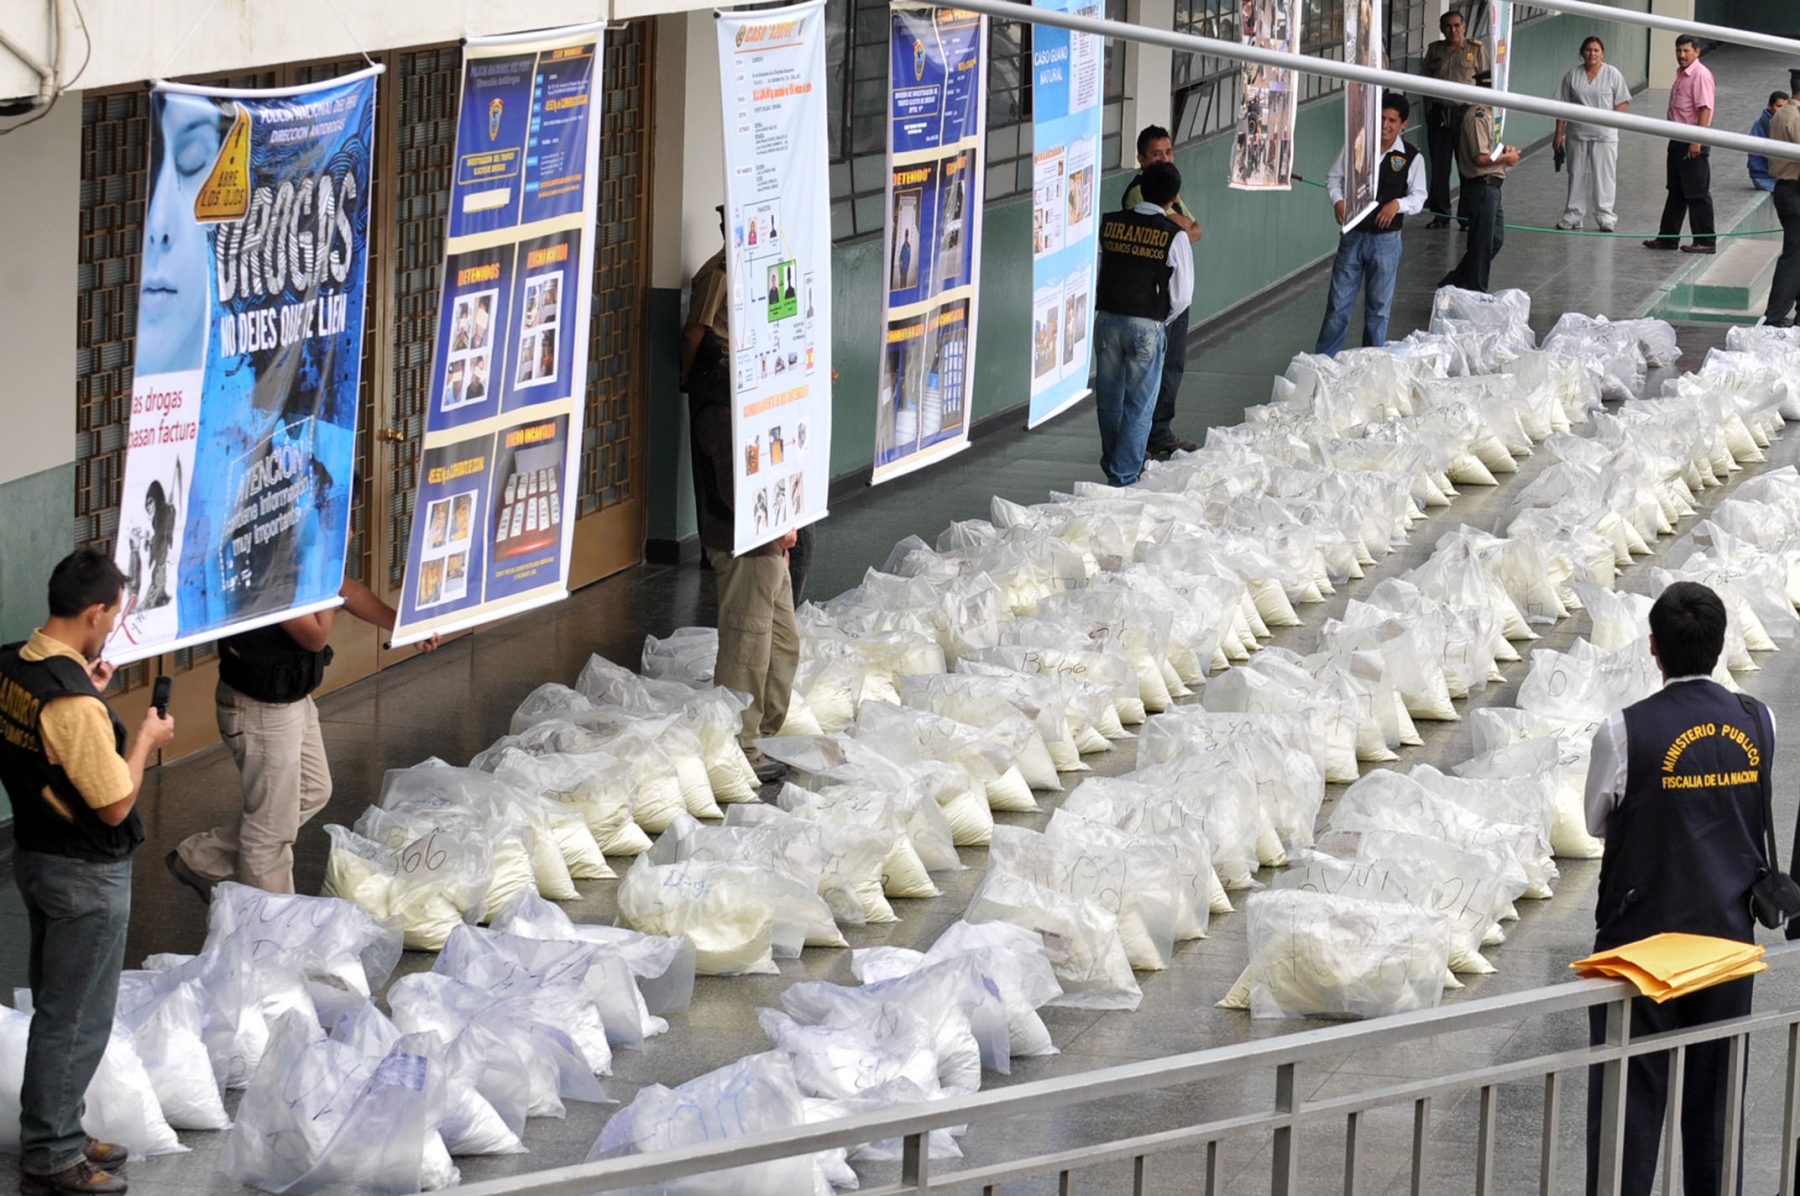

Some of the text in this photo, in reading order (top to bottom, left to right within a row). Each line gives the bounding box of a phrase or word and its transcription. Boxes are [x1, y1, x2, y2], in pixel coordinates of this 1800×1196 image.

[1034, 52, 1050, 66] CASO
[1039, 67, 1063, 86] NATURAL
[893, 168, 932, 187] DETENIDO
[216, 171, 357, 302] DROGAS
[1103, 221, 1169, 247] DIRANDRO
[1132, 245, 1164, 260] QUIMICOS
[457, 261, 501, 287] DETENIDOS
[220, 315, 236, 358] NO
[239, 307, 277, 353] DEJES
[131, 386, 183, 416] as drogas
[158, 418, 197, 443] factura
[1661, 722, 1760, 773] MINISTERIO PUBLICO
[1662, 770, 1759, 790] FISCALIA DE LA NACION
